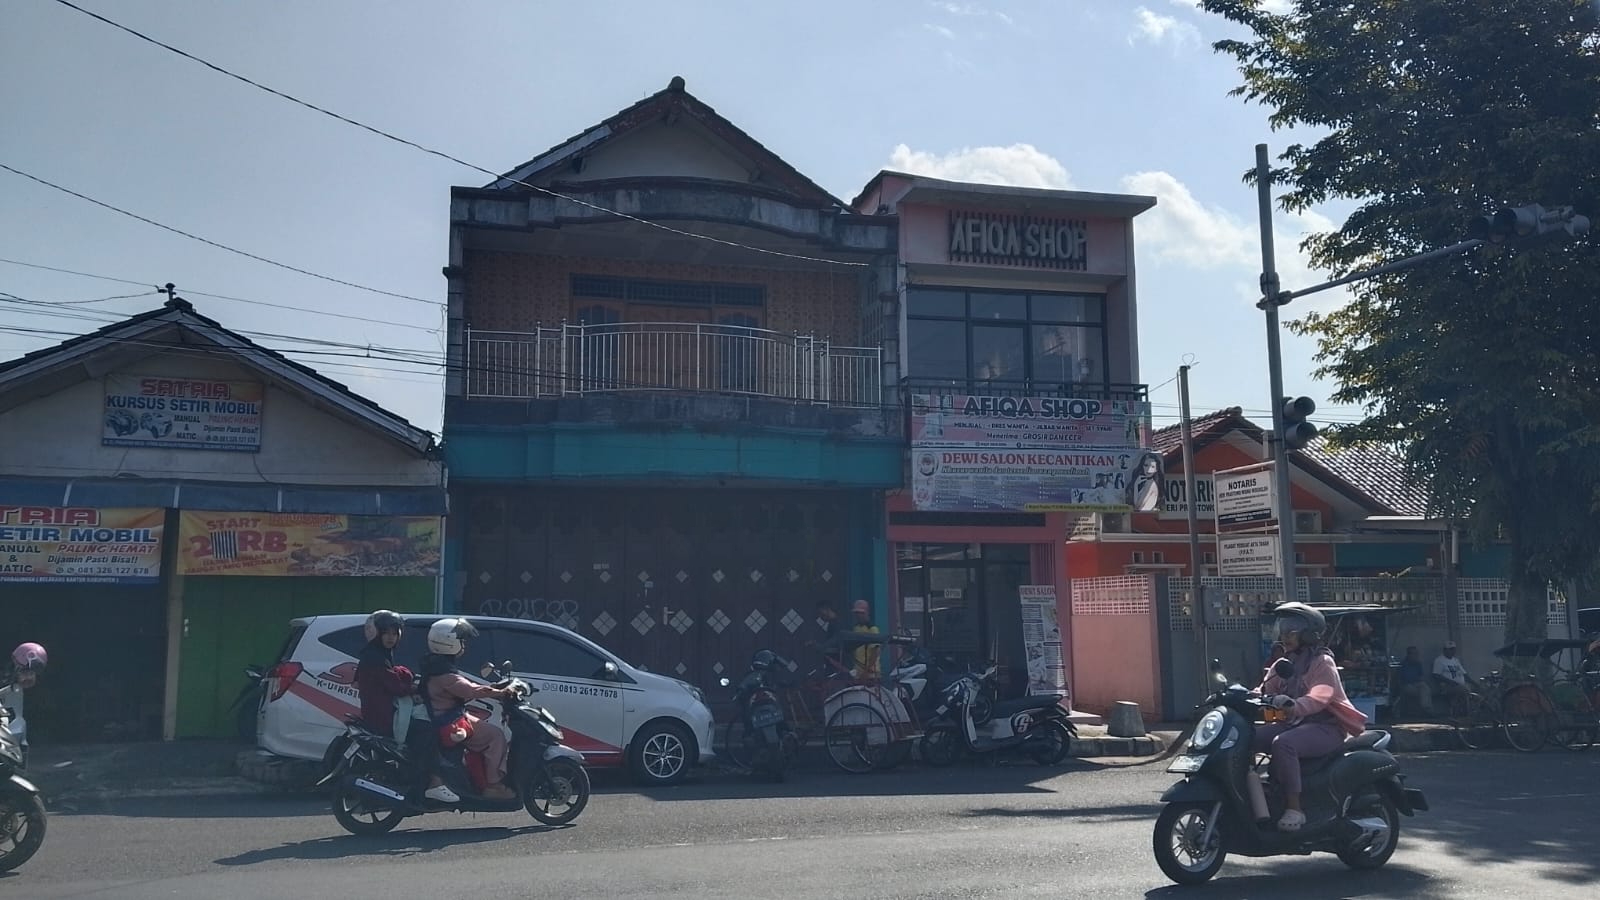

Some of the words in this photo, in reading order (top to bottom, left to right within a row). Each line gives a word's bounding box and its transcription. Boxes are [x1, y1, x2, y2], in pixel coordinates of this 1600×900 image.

[951, 218, 1020, 256] AFIQA
[1025, 223, 1087, 259] SHOP
[141, 378, 231, 400] SATRIA
[106, 395, 166, 411] KURSUS
[170, 398, 210, 414] SETIR
[214, 402, 259, 415] MOBIL
[963, 396, 1034, 418] AFIQA
[1040, 398, 1102, 420] SHOP
[174, 414, 201, 424] MANUAL
[176, 432, 197, 441] MATIC
[942, 452, 978, 464] DEWI
[980, 453, 1024, 465] SALON
[1028, 454, 1114, 466] KECANTIKAN
[1228, 478, 1256, 490] NOTARIS
[206, 517, 261, 530] START
[70, 528, 158, 543] MOBIL
[57, 544, 108, 554] PALING
[108, 544, 158, 554] HEMAT
[47, 555, 83, 564] Dijamin
[85, 555, 109, 564] Pasti
[77, 566, 94, 574] 081
[559, 684, 578, 694] 0813
[580, 686, 598, 696] 2612
[600, 688, 618, 698] 7678
